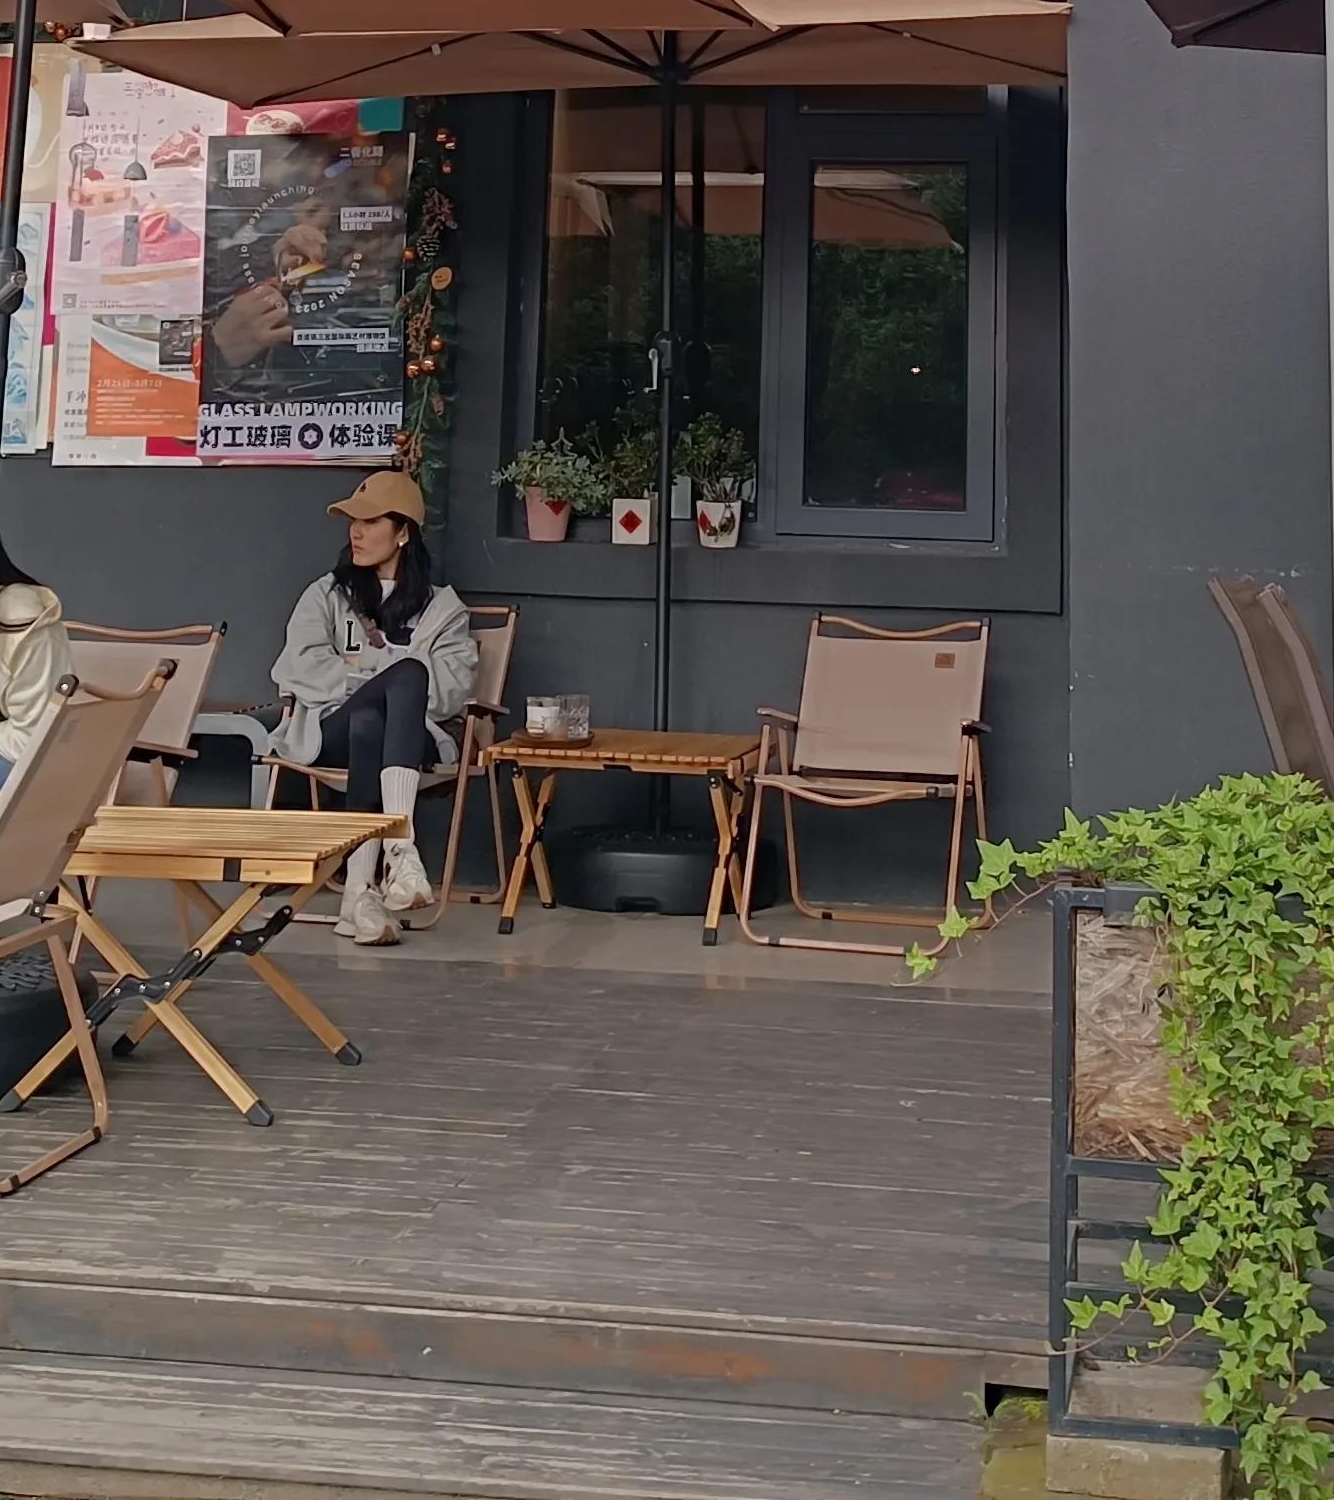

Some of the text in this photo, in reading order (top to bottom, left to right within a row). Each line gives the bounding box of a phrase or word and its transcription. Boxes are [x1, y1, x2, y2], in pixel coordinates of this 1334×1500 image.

[198, 402, 255, 418] GLASS
[259, 401, 403, 417] LAMPWORKING
[199, 423, 398, 449] 灯工玻璃 体验课
[345, 619, 362, 652] L
